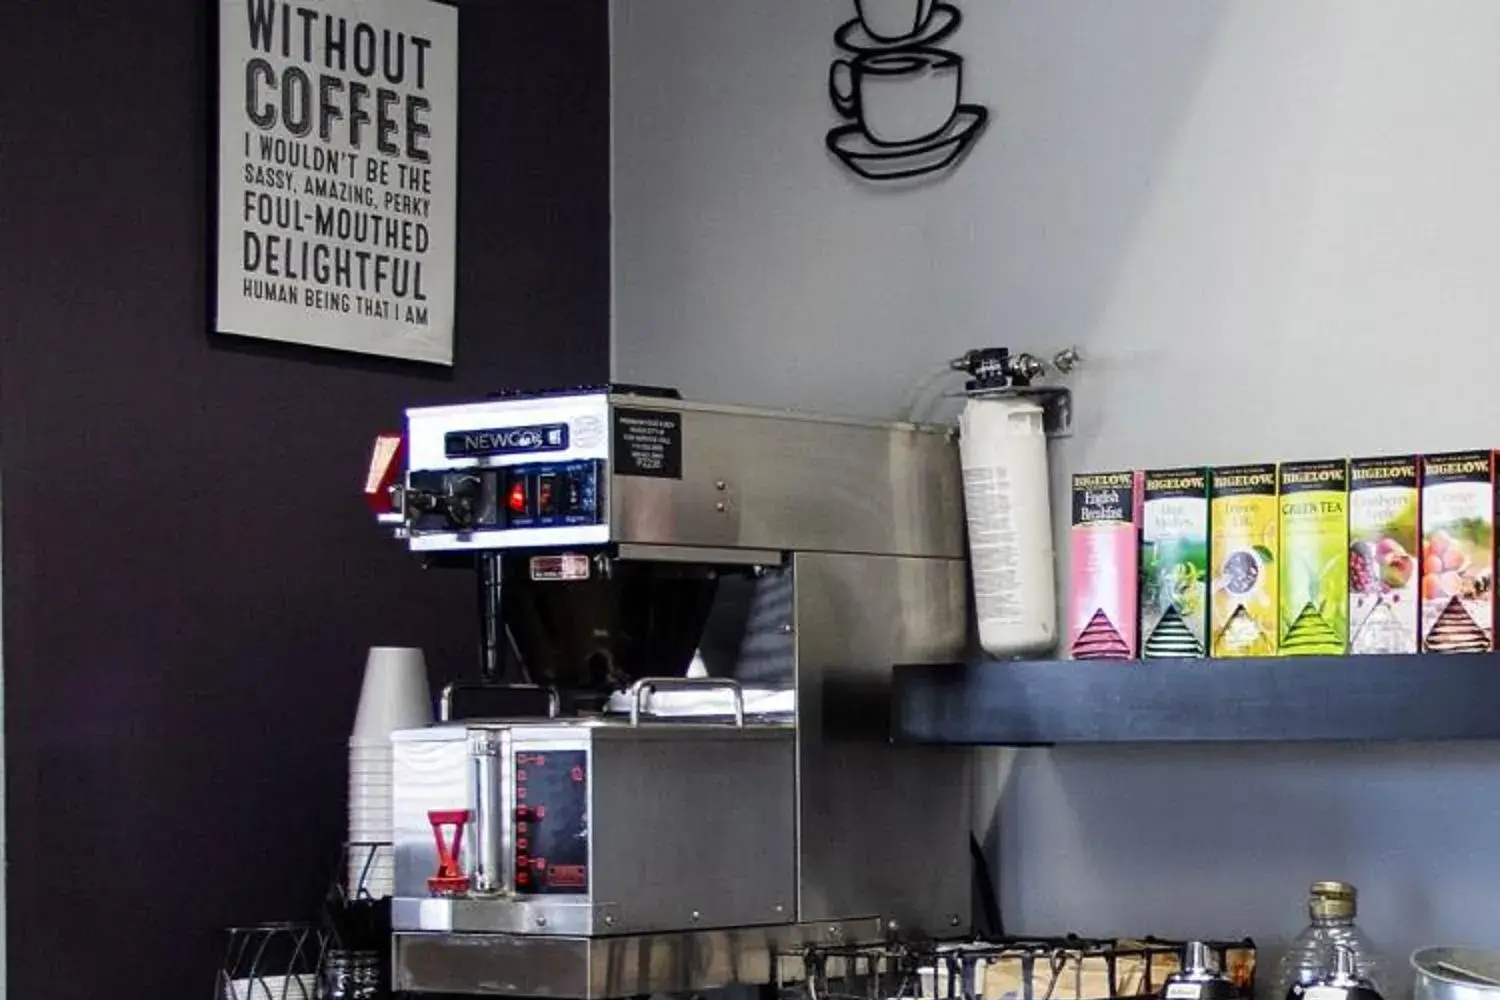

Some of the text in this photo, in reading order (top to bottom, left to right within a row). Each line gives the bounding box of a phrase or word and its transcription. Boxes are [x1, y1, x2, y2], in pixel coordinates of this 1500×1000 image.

[247, 0, 432, 89] WITHOUT
[245, 58, 432, 163] COFFEE
[245, 132, 431, 194] I WOULDN'T BE THE
[384, 191, 431, 218] PERKY
[244, 190, 429, 253] FOUL-MOUTHED
[243, 230, 427, 300] DELIGHTFUL
[243, 278, 429, 325] HUMAN BEING THAT I AM
[1282, 469, 1345, 484] BIGELOW
[1352, 465, 1415, 480] BIGELOW
[1424, 459, 1489, 475] BIGELOW
[1073, 474, 1132, 487] BIGELOW
[1147, 476, 1205, 490] BIGELOW
[1213, 473, 1275, 488] BIGELOW
[1320, 501, 1343, 513] TEA
